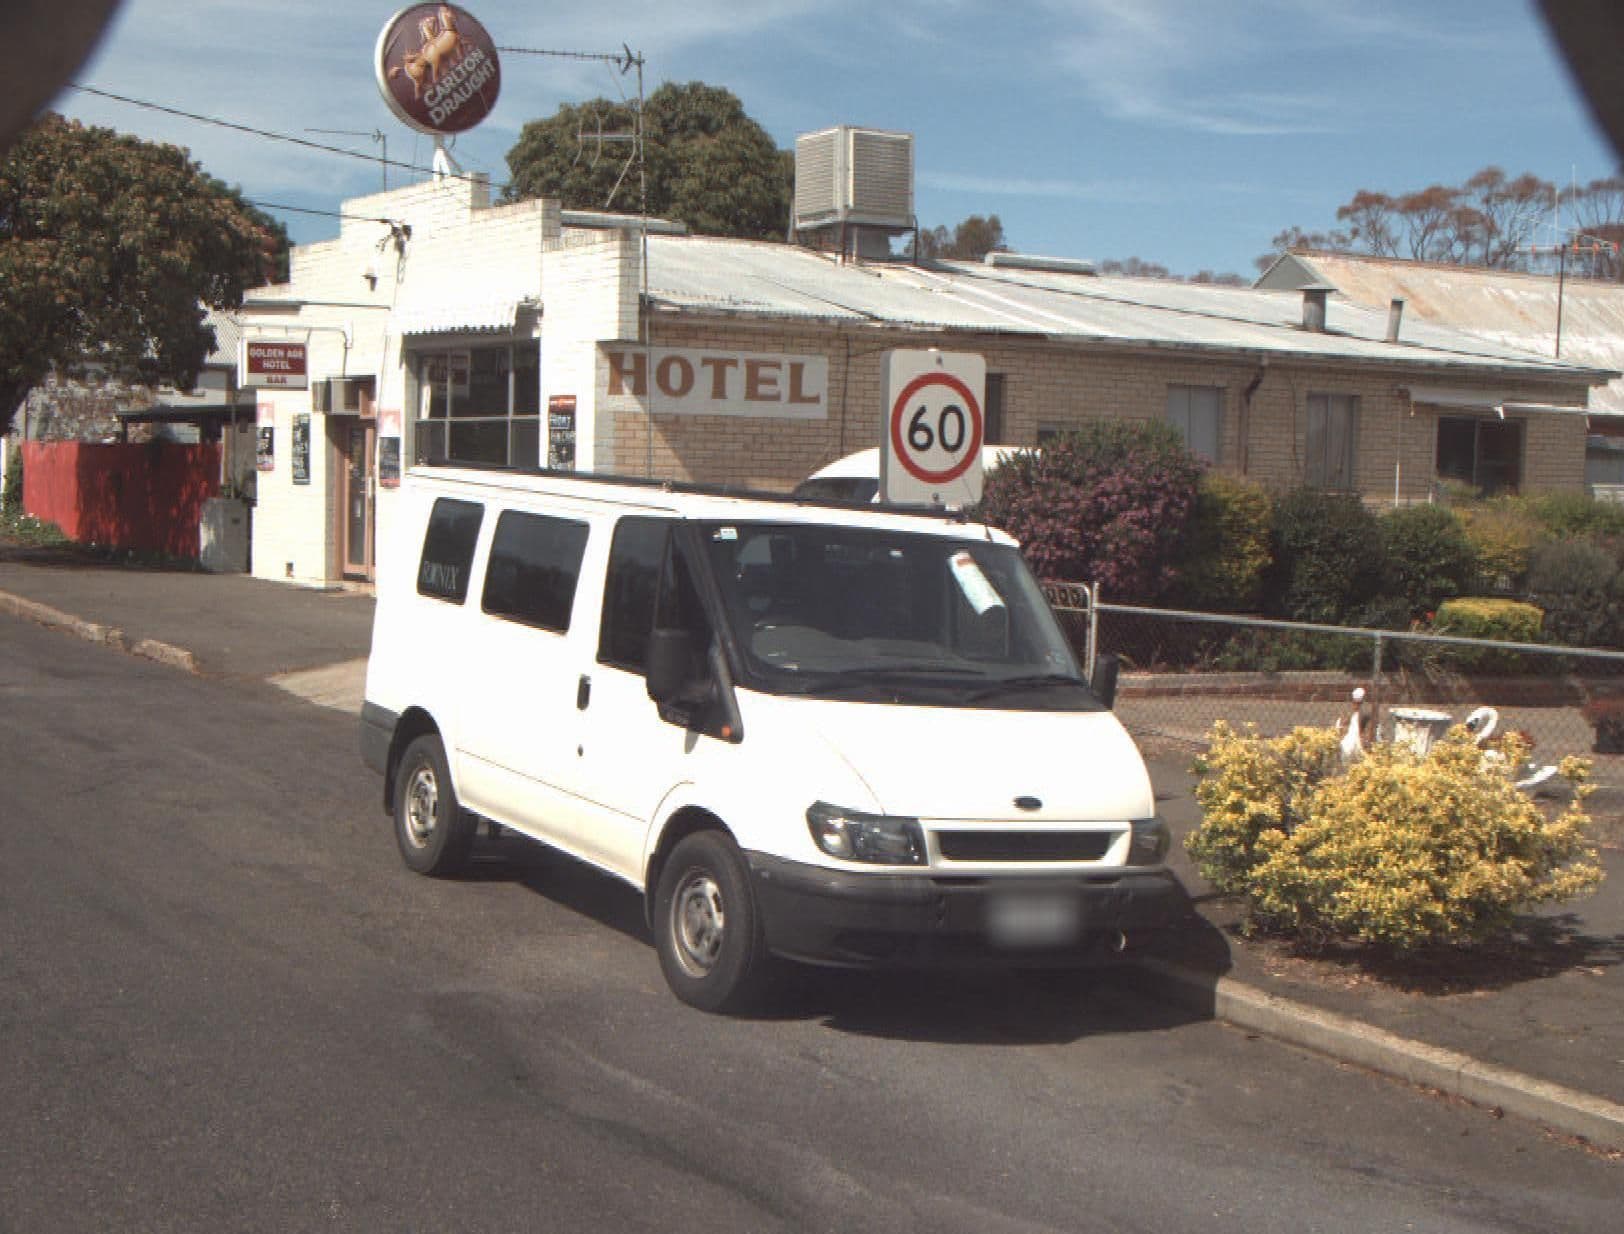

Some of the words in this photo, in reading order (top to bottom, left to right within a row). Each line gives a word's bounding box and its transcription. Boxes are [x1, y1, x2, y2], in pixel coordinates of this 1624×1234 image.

[423, 48, 485, 108] CARLTON
[430, 58, 496, 125] DRAUGHT
[249, 348, 285, 358] GOLDEN
[262, 359, 291, 370] HOTEL
[266, 375, 288, 384] BAR
[607, 352, 820, 404] HOTEL
[908, 404, 965, 453] 60
